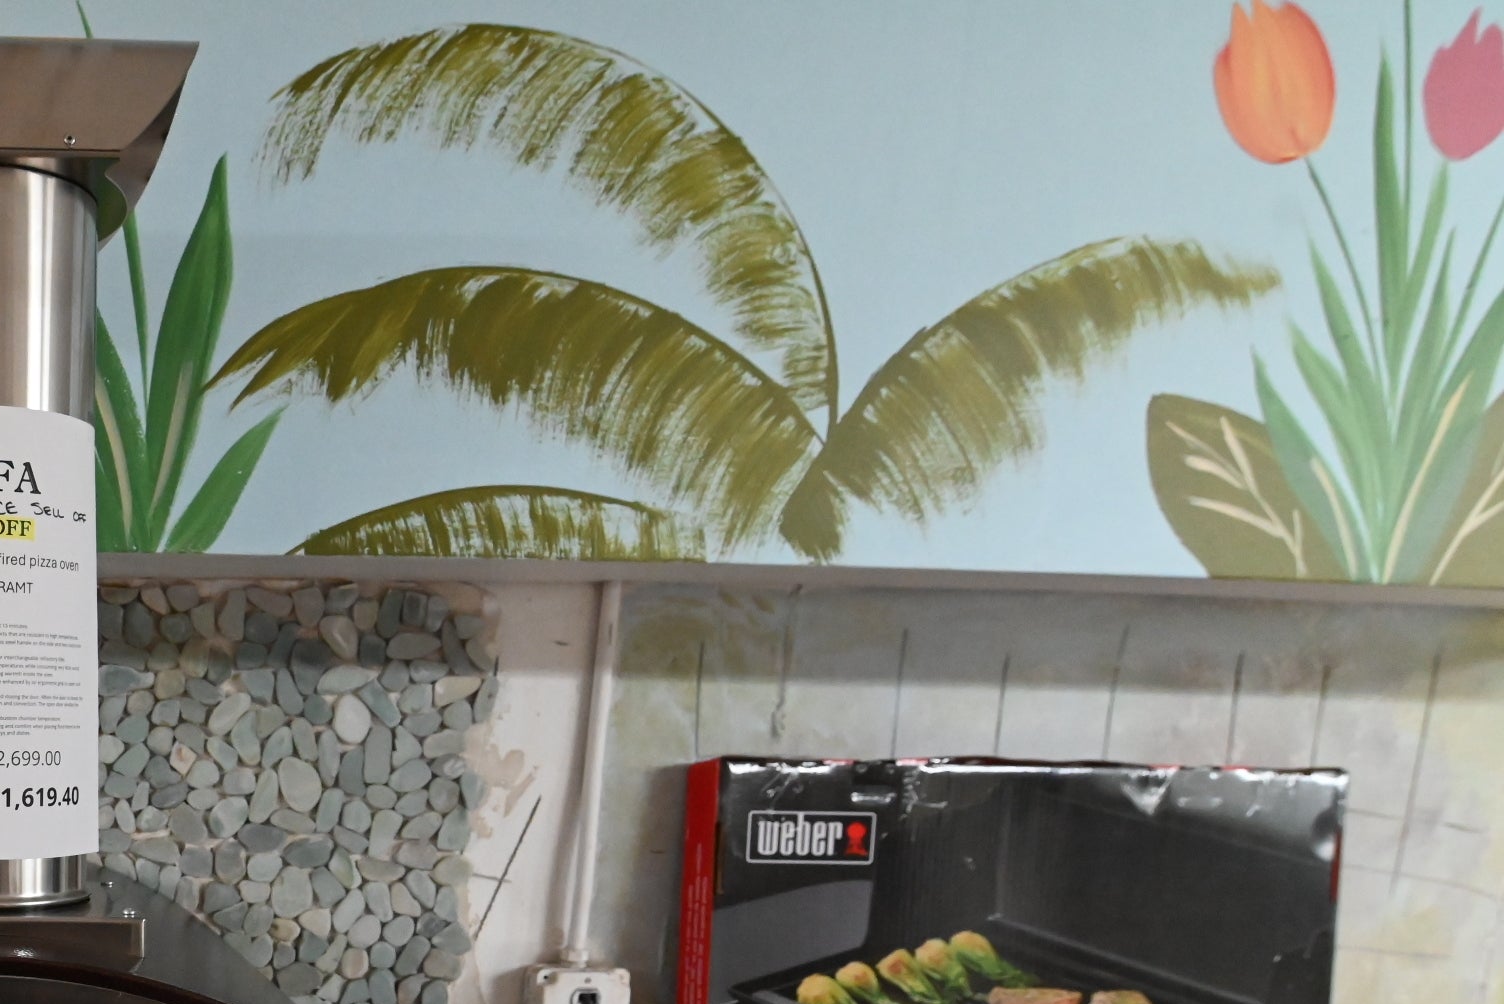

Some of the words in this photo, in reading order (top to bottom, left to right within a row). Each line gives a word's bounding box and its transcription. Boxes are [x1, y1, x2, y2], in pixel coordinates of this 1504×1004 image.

[29, 554, 57, 570] pizza
[60, 560, 79, 572] oven
[757, 815, 843, 856] weber
